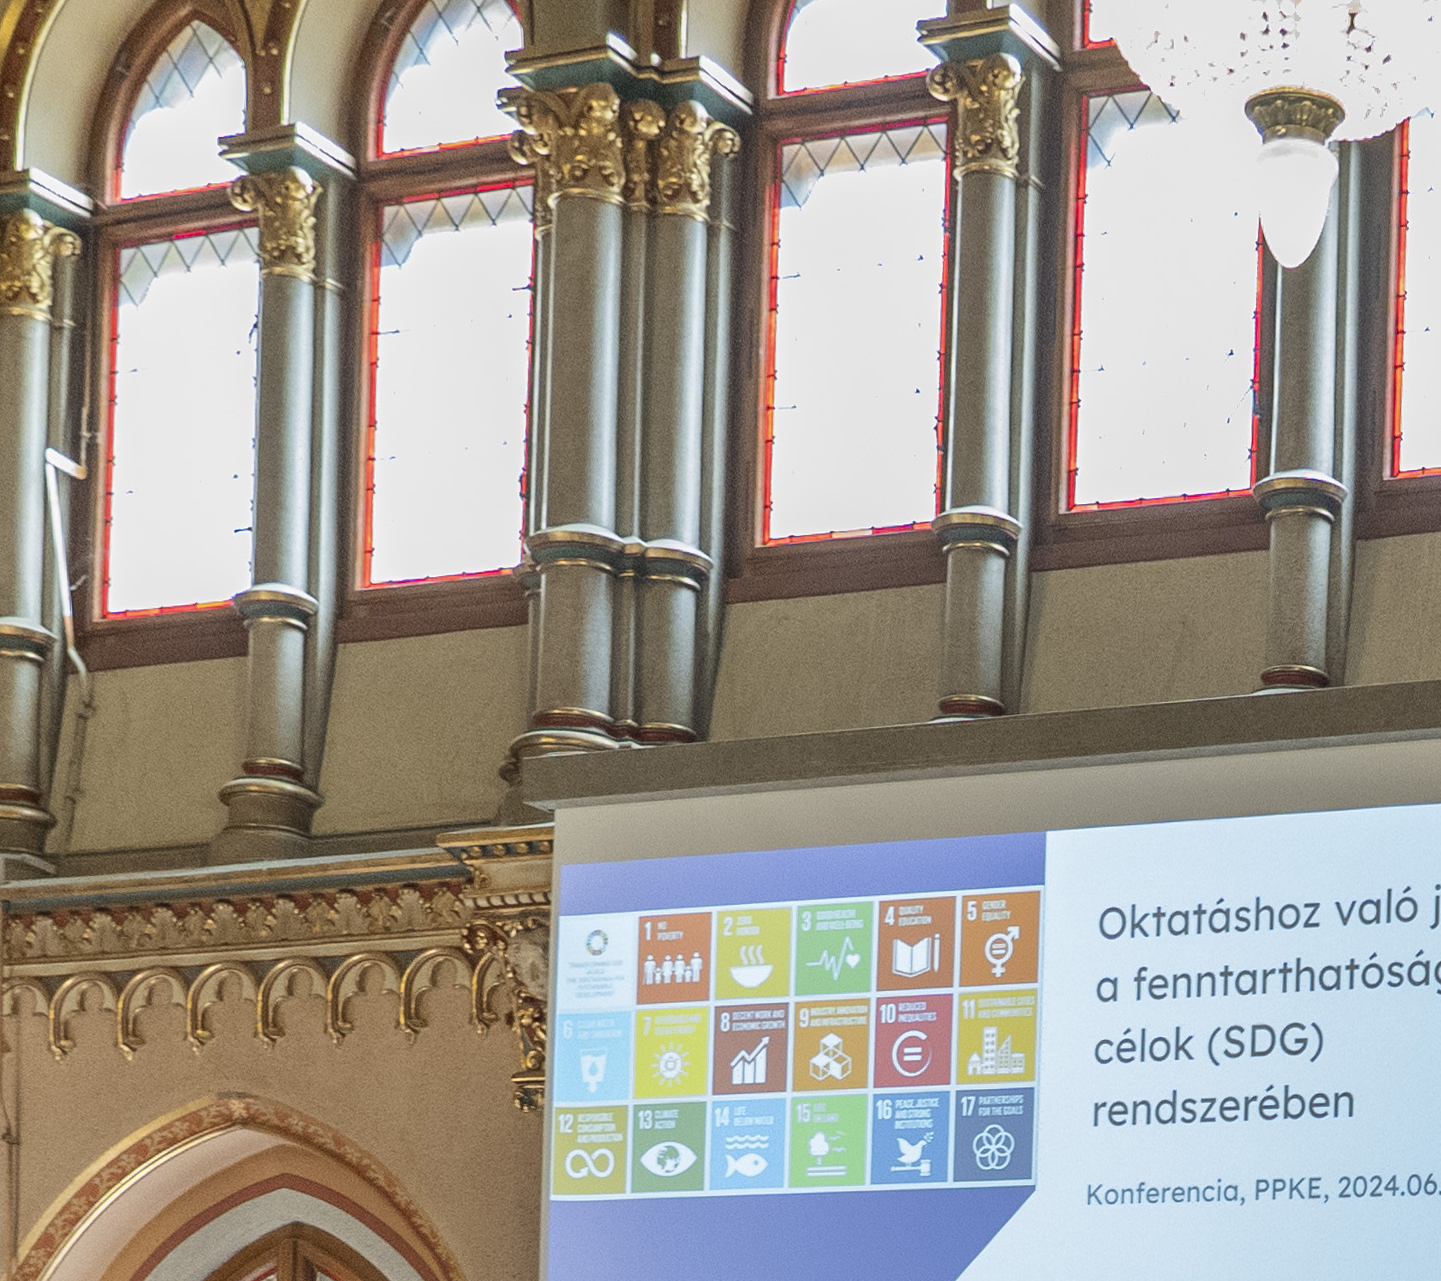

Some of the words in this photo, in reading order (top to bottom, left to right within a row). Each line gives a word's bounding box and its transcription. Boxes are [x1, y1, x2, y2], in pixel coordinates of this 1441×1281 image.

[802, 911, 812, 931] 3
[884, 906, 895, 926] 4
[966, 901, 977, 921] 5
[1099, 897, 1320, 940] Oktatáshoz
[1336, 886, 1418, 926] való
[644, 921, 652, 941] 1
[723, 916, 733, 936] 2
[1096, 976, 1118, 1002] a
[799, 1008, 810, 1028] 9
[880, 1003, 897, 1024] 10
[962, 999, 976, 1019] 11
[720, 1012, 730, 1032] 8
[1094, 1026, 1194, 1064] célok
[1208, 1021, 1324, 1066] (SDG)
[796, 1103, 810, 1123] 15
[876, 1099, 892, 1120] 16
[961, 1096, 976, 1116] 17
[1093, 1084, 1354, 1127] rendszerében
[558, 1114, 573, 1134] 12
[638, 1110, 653, 1130] 13
[715, 1107, 730, 1127] 14
[1086, 1178, 1246, 1206] Konferencia,
[1255, 1176, 1329, 1203] PPKE,
